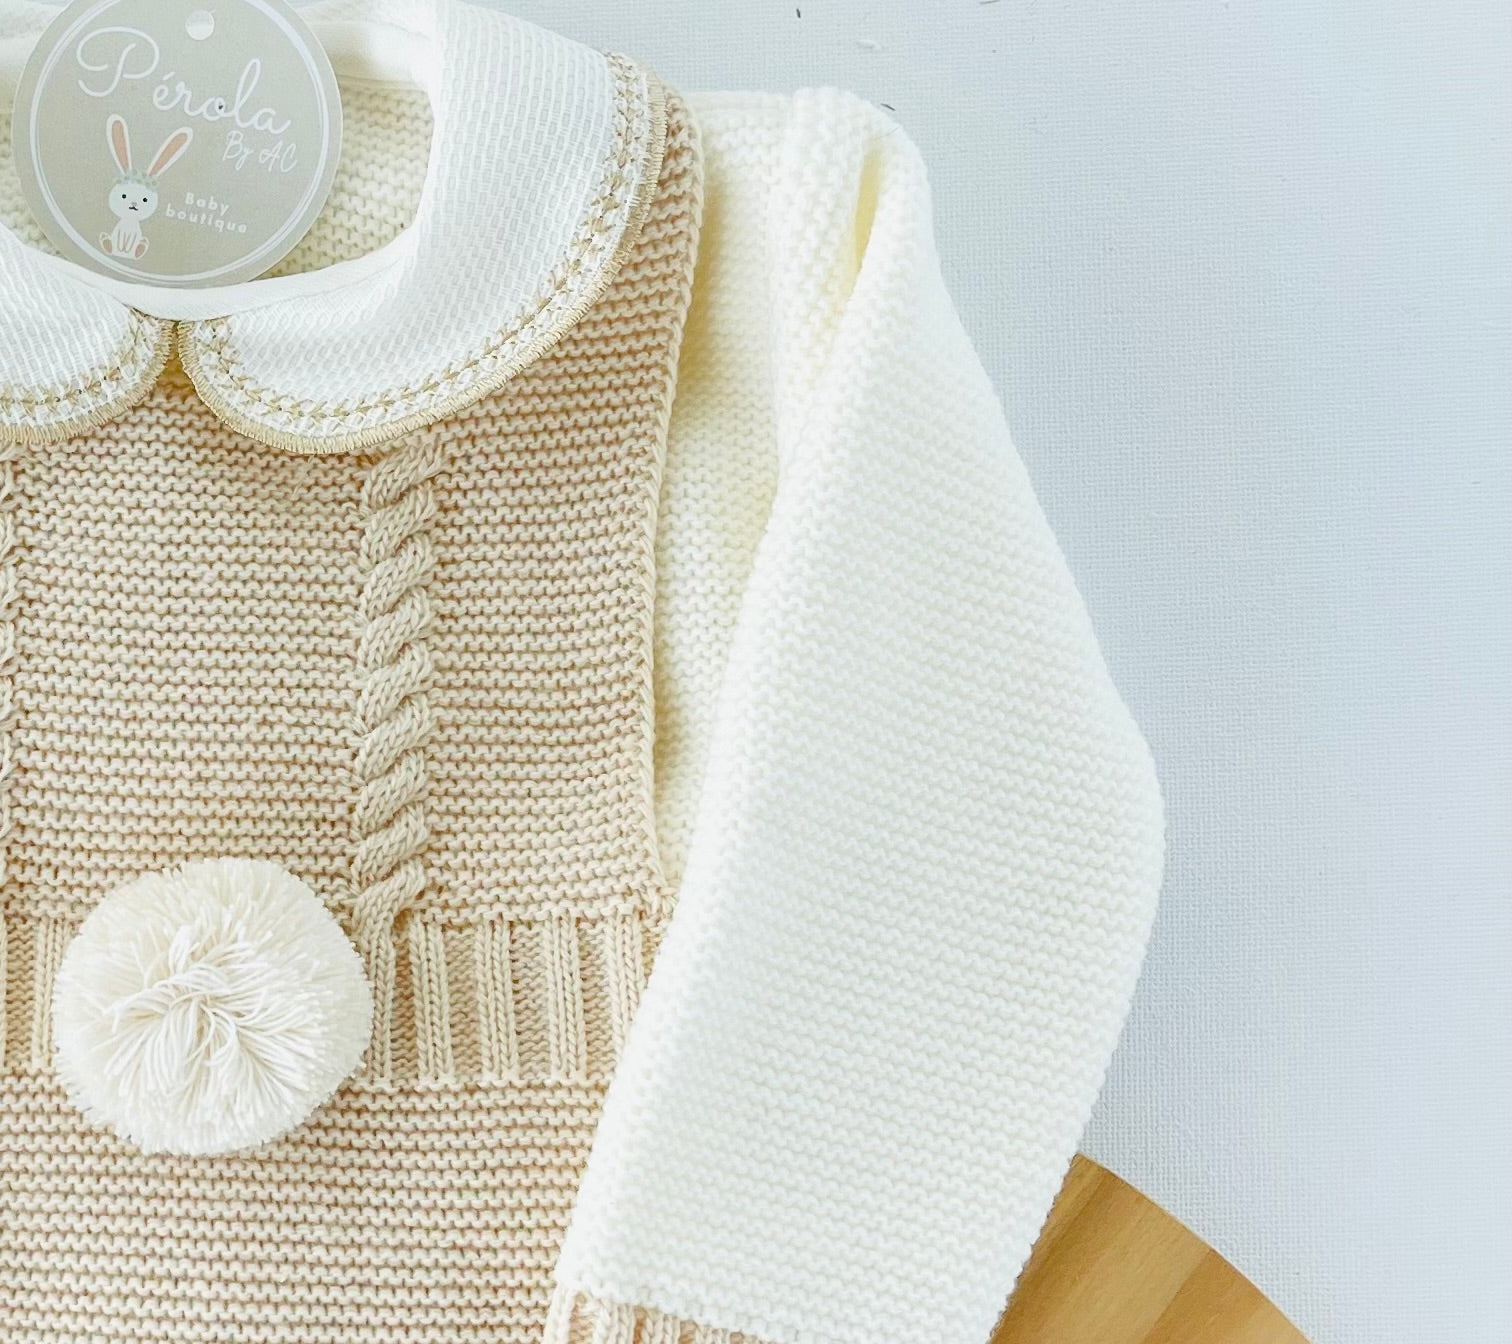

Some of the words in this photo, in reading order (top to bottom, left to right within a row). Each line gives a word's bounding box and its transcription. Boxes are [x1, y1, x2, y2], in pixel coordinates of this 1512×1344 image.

[75, 25, 292, 135] Pérola
[221, 130, 255, 171] By
[258, 140, 299, 173] AC
[165, 203, 248, 233] boutique
[184, 191, 230, 217] Baby
